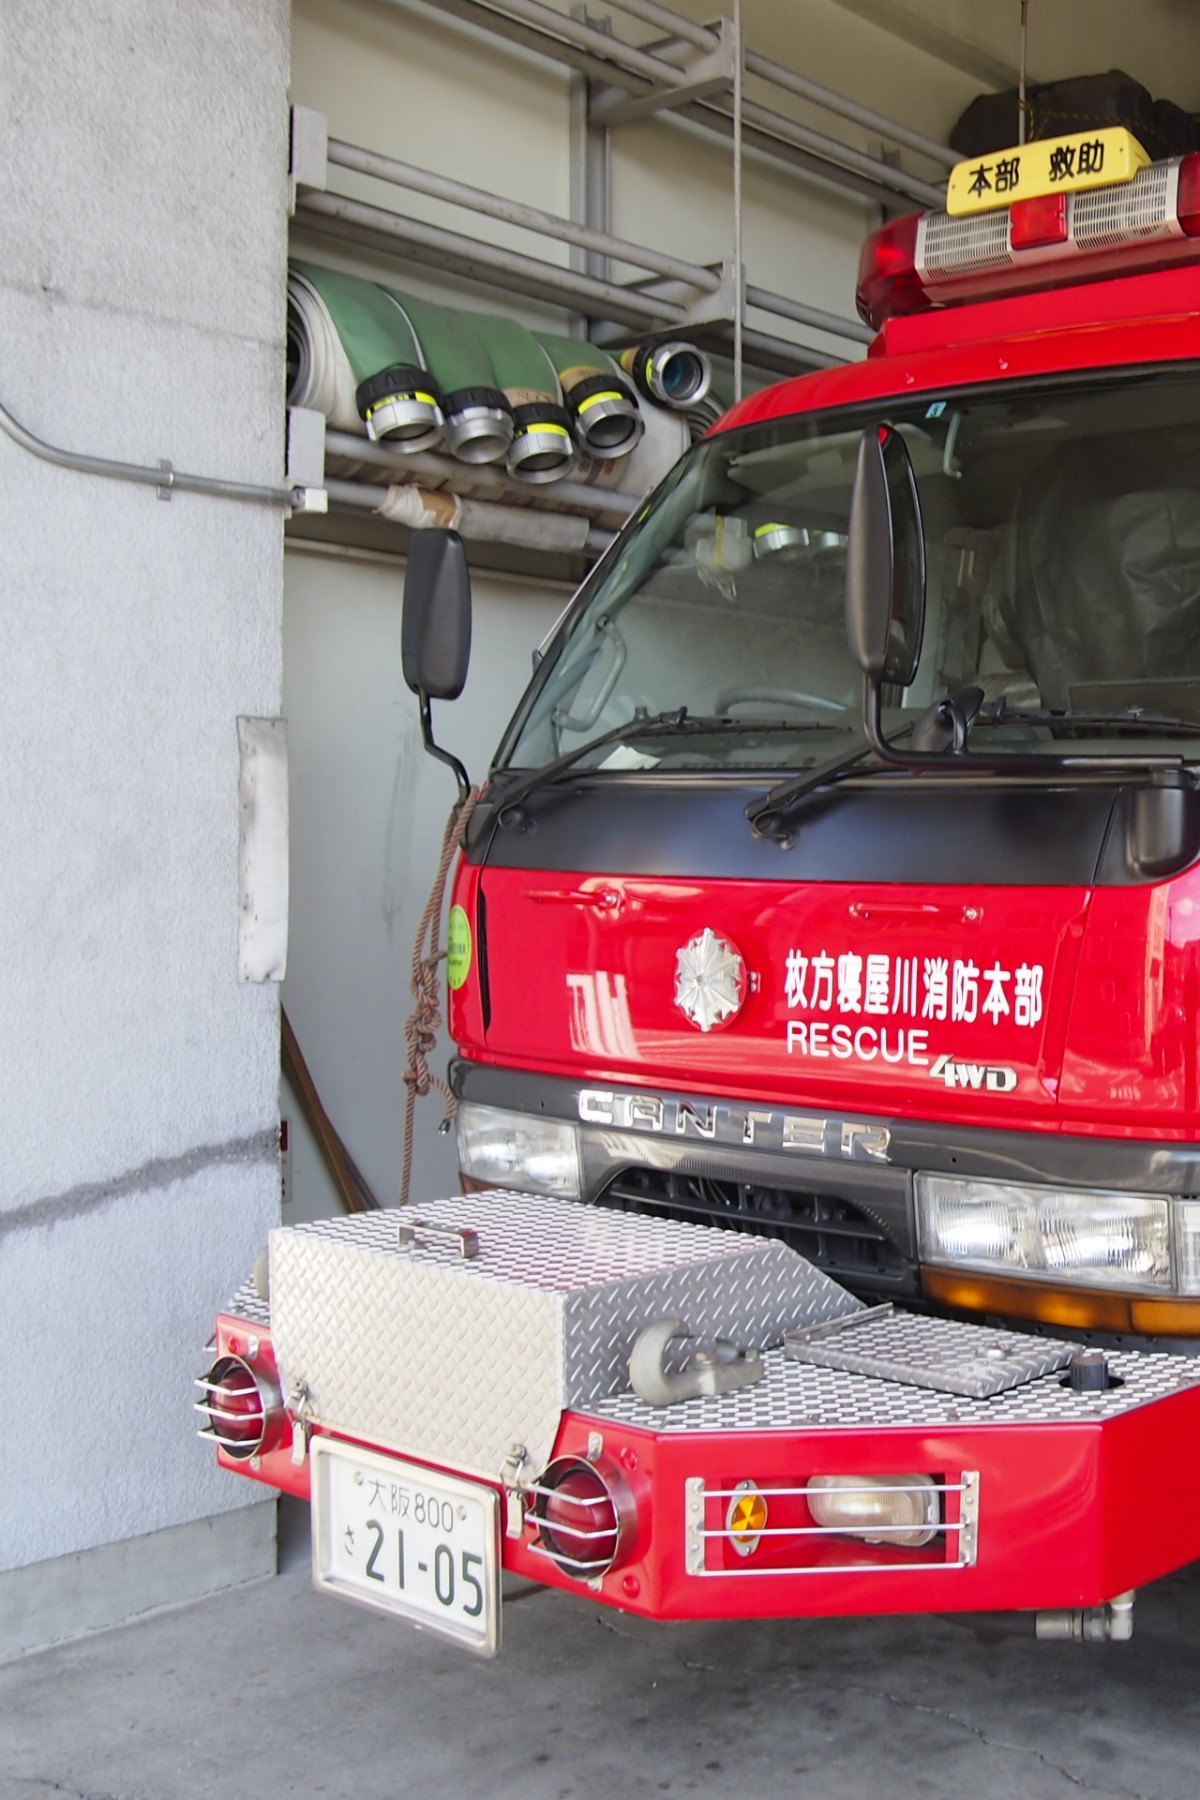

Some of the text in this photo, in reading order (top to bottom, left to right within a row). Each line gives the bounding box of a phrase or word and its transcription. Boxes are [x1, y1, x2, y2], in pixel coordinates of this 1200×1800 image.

[968, 139, 1105, 198] 本部 救助
[784, 948, 1044, 1028] 枚方寝屋川消防本部
[786, 1020, 929, 1066] RESCUE
[929, 1053, 1018, 1092] 4WD
[578, 1088, 893, 1162] CANTER
[344, 1519, 483, 1618] さ 21-05
